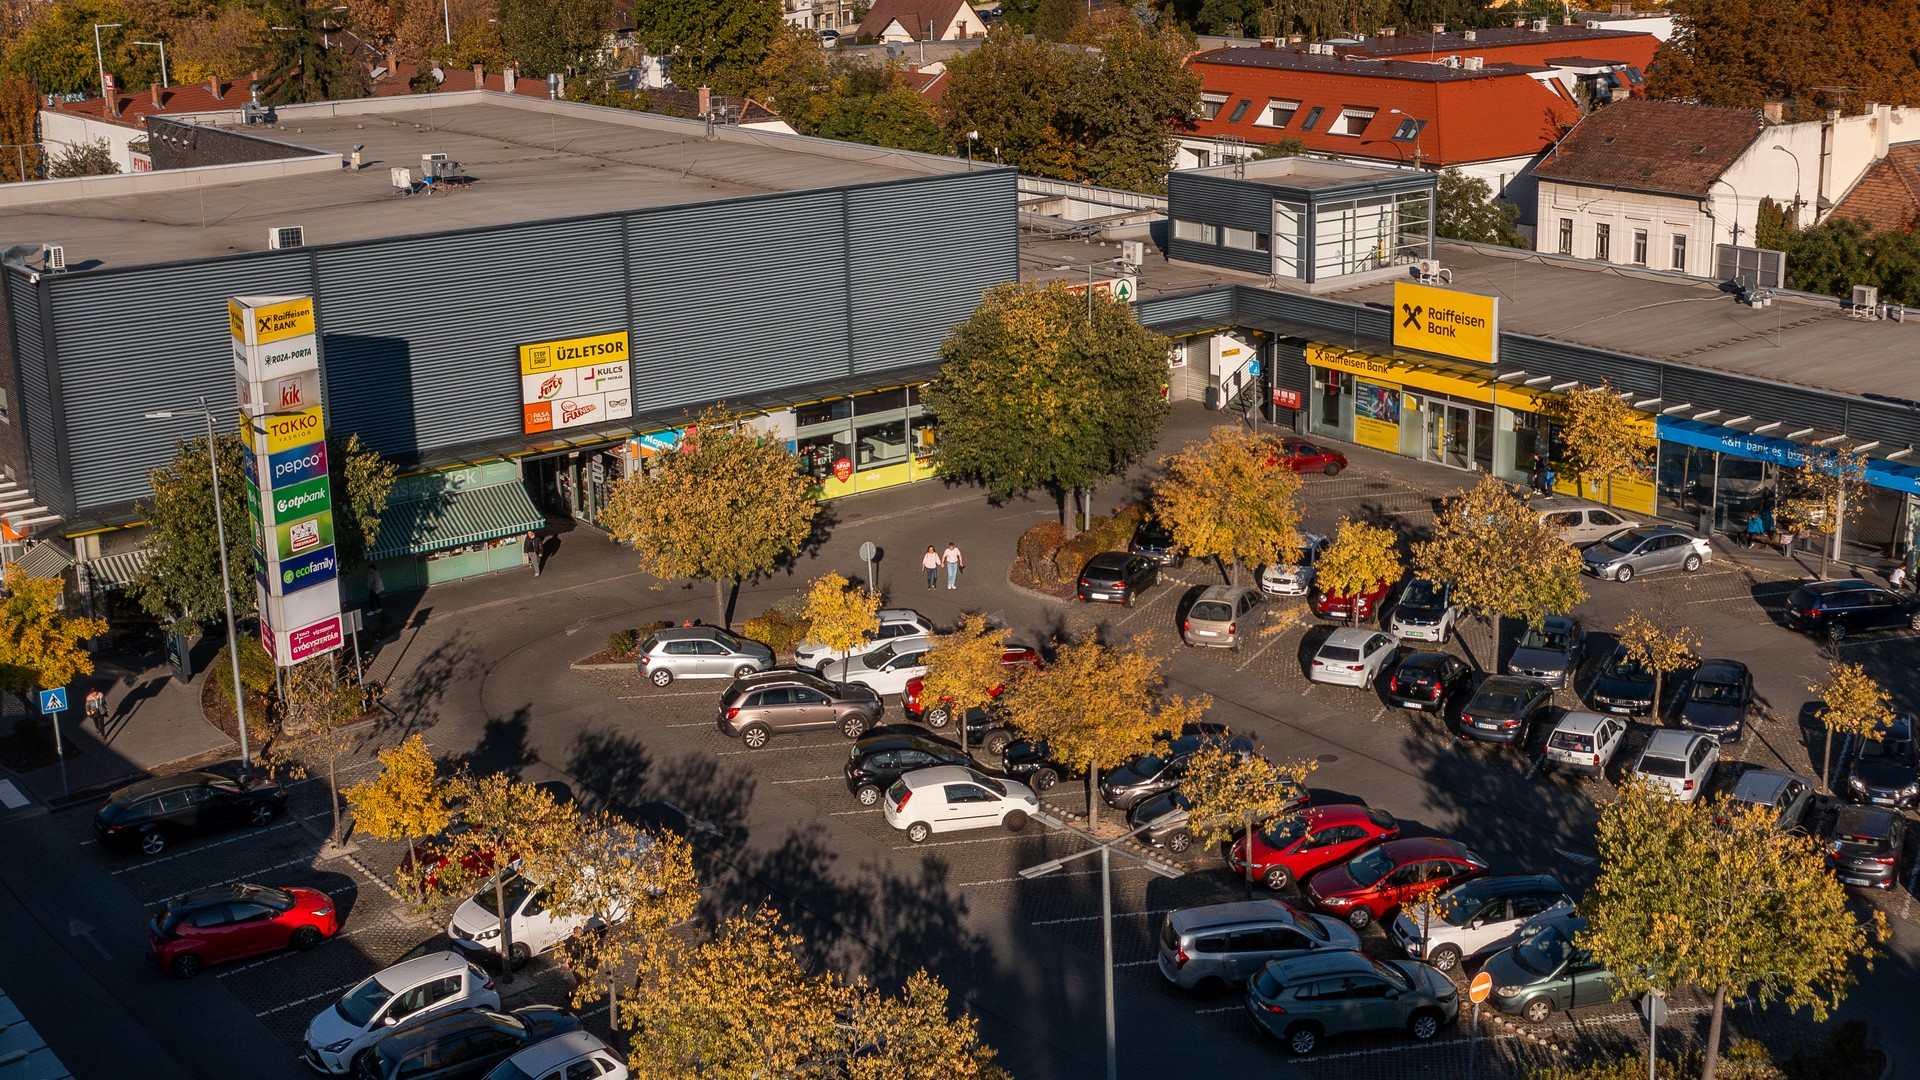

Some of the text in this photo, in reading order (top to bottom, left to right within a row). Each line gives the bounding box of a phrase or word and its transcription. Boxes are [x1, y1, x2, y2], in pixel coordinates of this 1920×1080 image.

[133, 157, 151, 171] FITNE
[273, 309, 310, 322] Raiffeisen
[1428, 307, 1485, 328] Raiffeisen
[273, 319, 297, 332] BANK
[1428, 322, 1456, 338] Bank
[271, 347, 312, 364] ROZA-PORTA
[557, 341, 624, 361] ÜZLETSOR
[533, 357, 547, 365] SHOP
[1324, 352, 1389, 375] Raiffeisen Bank
[597, 366, 623, 376] KULCS
[533, 415, 550, 424] KEBAB
[562, 403, 596, 423] FITNESS
[279, 430, 312, 443] FASHION
[1721, 435, 1741, 449] K&H
[1746, 440, 1769, 454] bank
[1771, 446, 1782, 457] és
[275, 454, 320, 479] pepco
[295, 557, 334, 579] ecofamily
